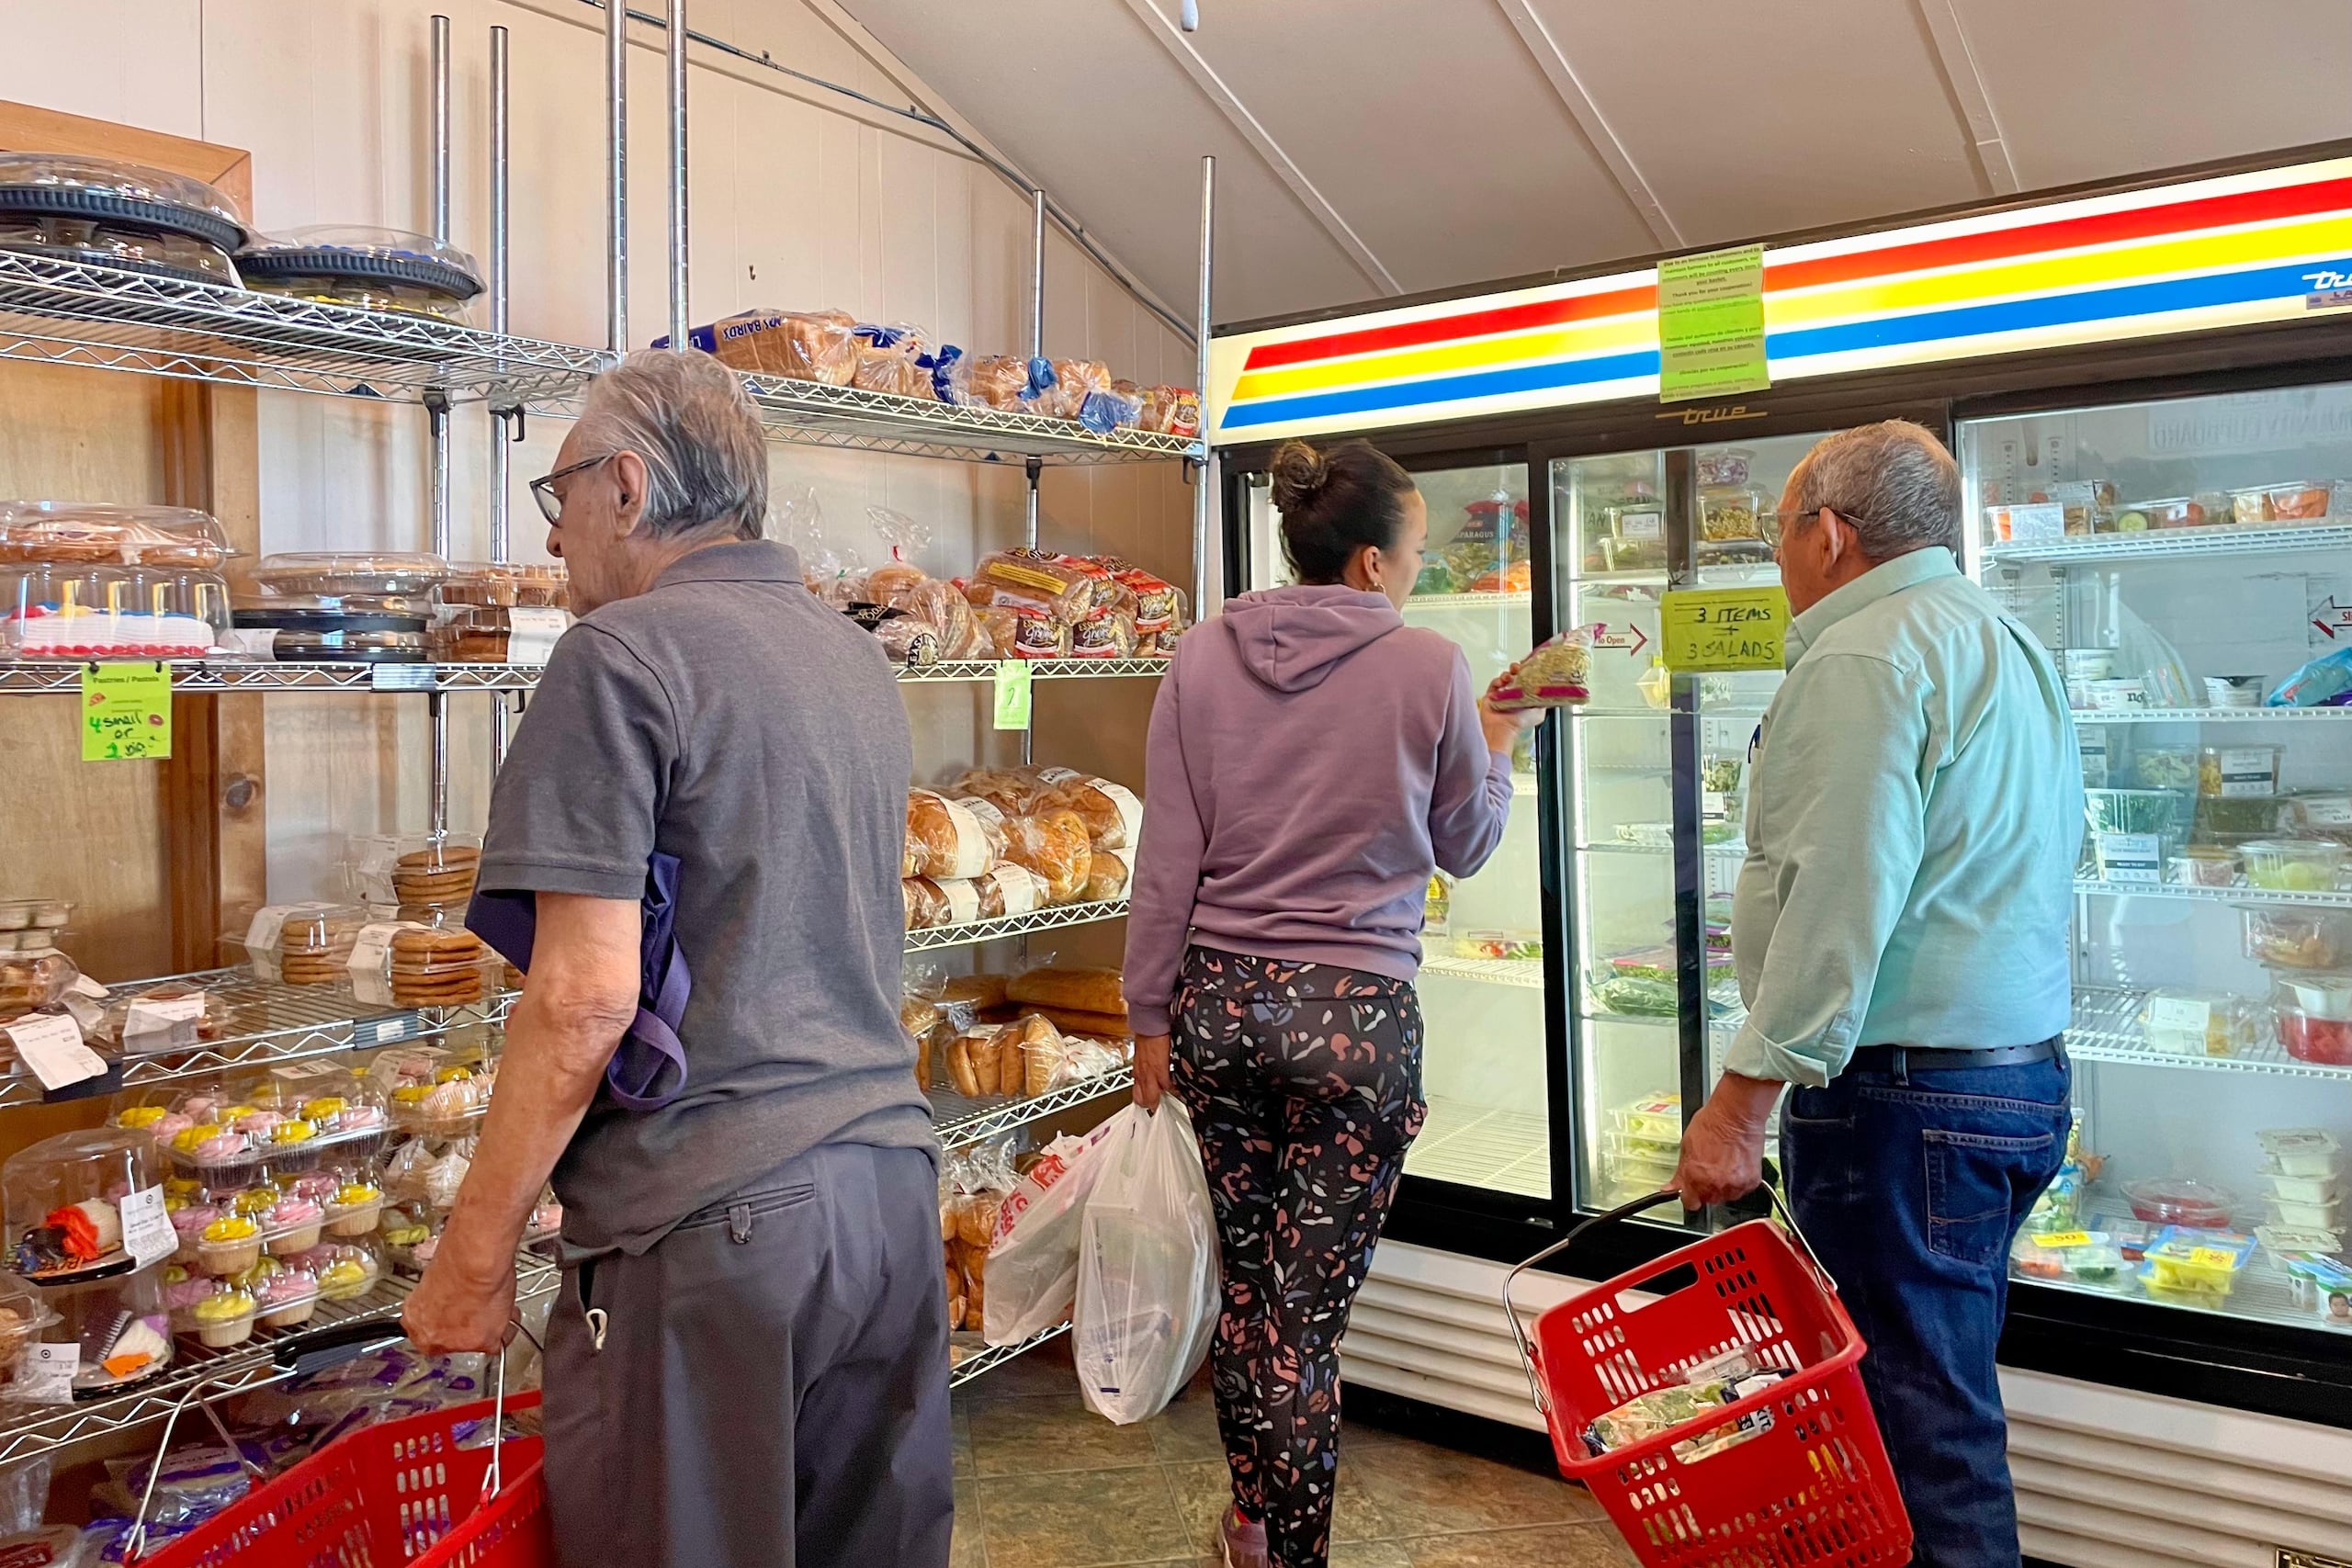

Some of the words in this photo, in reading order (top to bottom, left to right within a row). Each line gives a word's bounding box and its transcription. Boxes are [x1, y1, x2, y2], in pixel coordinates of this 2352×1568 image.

[2301, 270, 2352, 289] tr
[1656, 405, 1768, 424] true
[1694, 607, 1707, 623] 3
[1717, 608, 1771, 623] ITEMS
[1606, 636, 1625, 647] Open
[1687, 643, 1698, 660] 3
[1702, 641, 1775, 660] SALADS
[2127, 692, 2144, 703] no
[90, 716, 101, 733] 4
[103, 711, 141, 728] small
[115, 728, 134, 739] or
